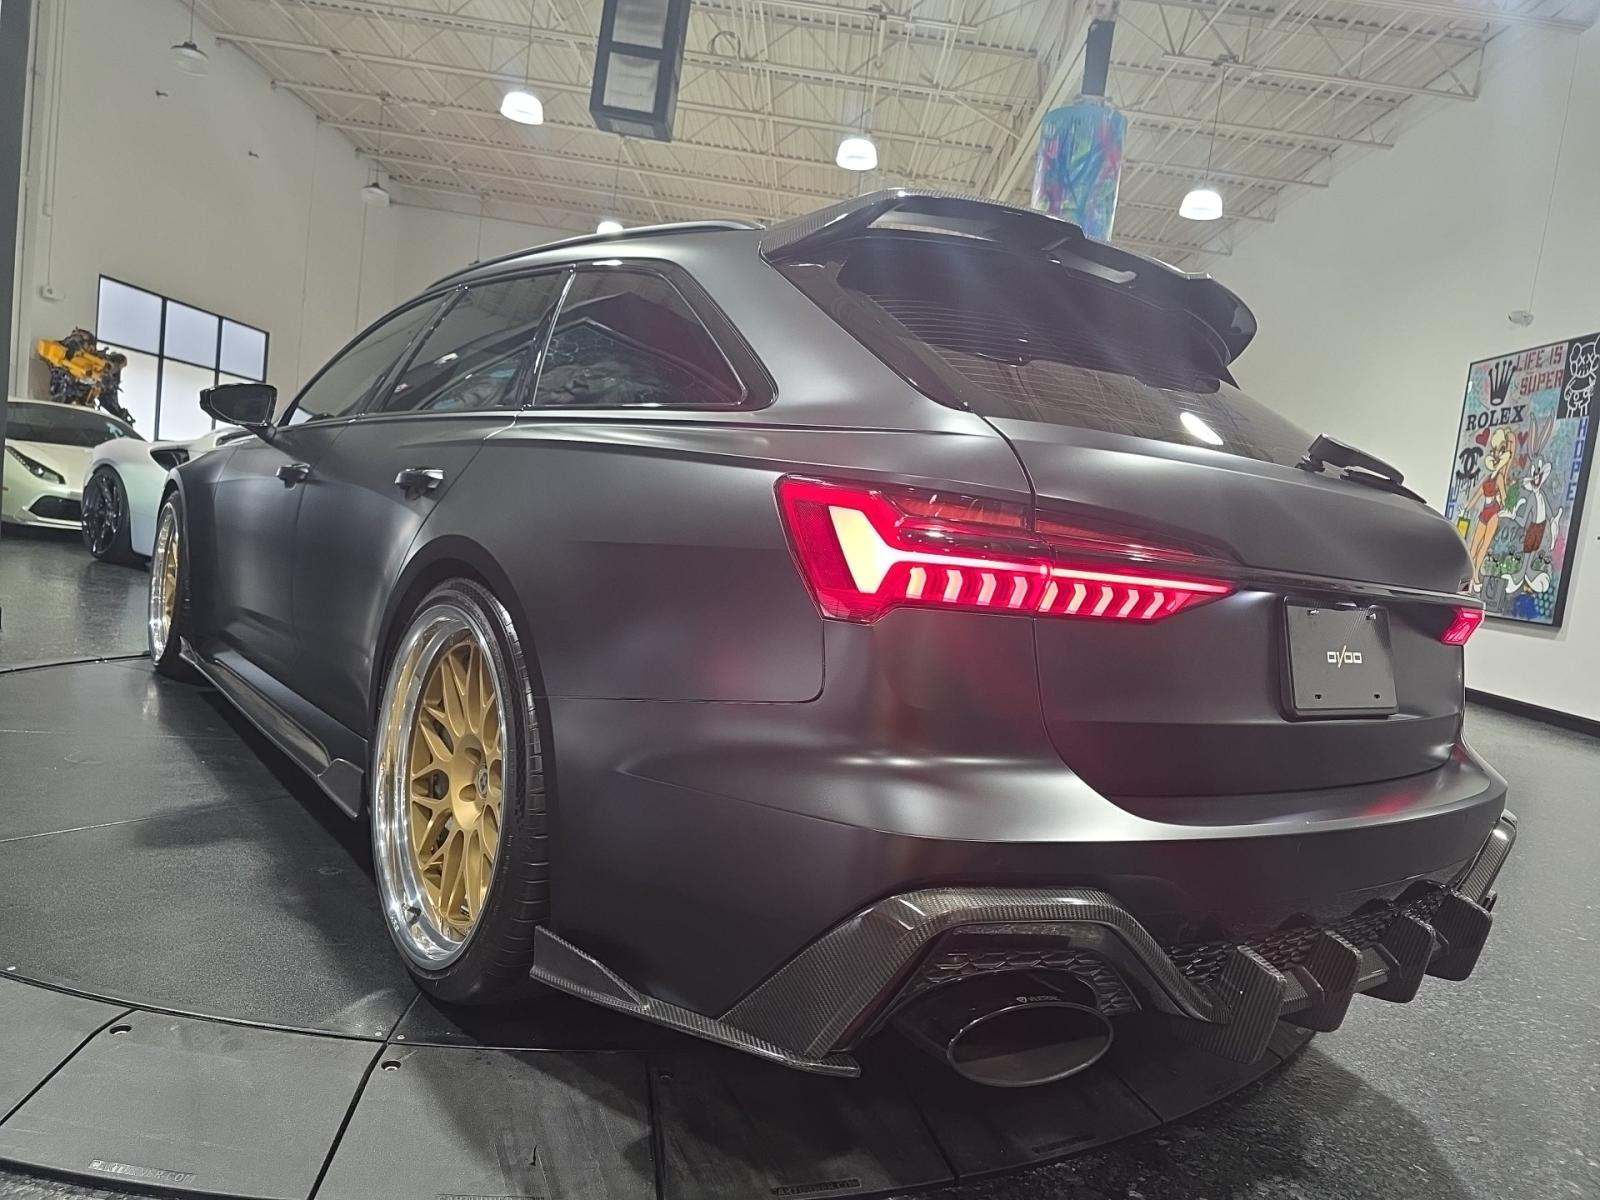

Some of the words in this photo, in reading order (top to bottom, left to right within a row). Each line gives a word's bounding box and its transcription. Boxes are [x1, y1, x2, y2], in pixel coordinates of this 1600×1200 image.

[1516, 349, 1545, 372] LIFE
[1549, 345, 1563, 366] IS
[1519, 369, 1564, 396] SUPER
[1465, 404, 1526, 431] ROLEX
[1565, 417, 1588, 501] HOPE
